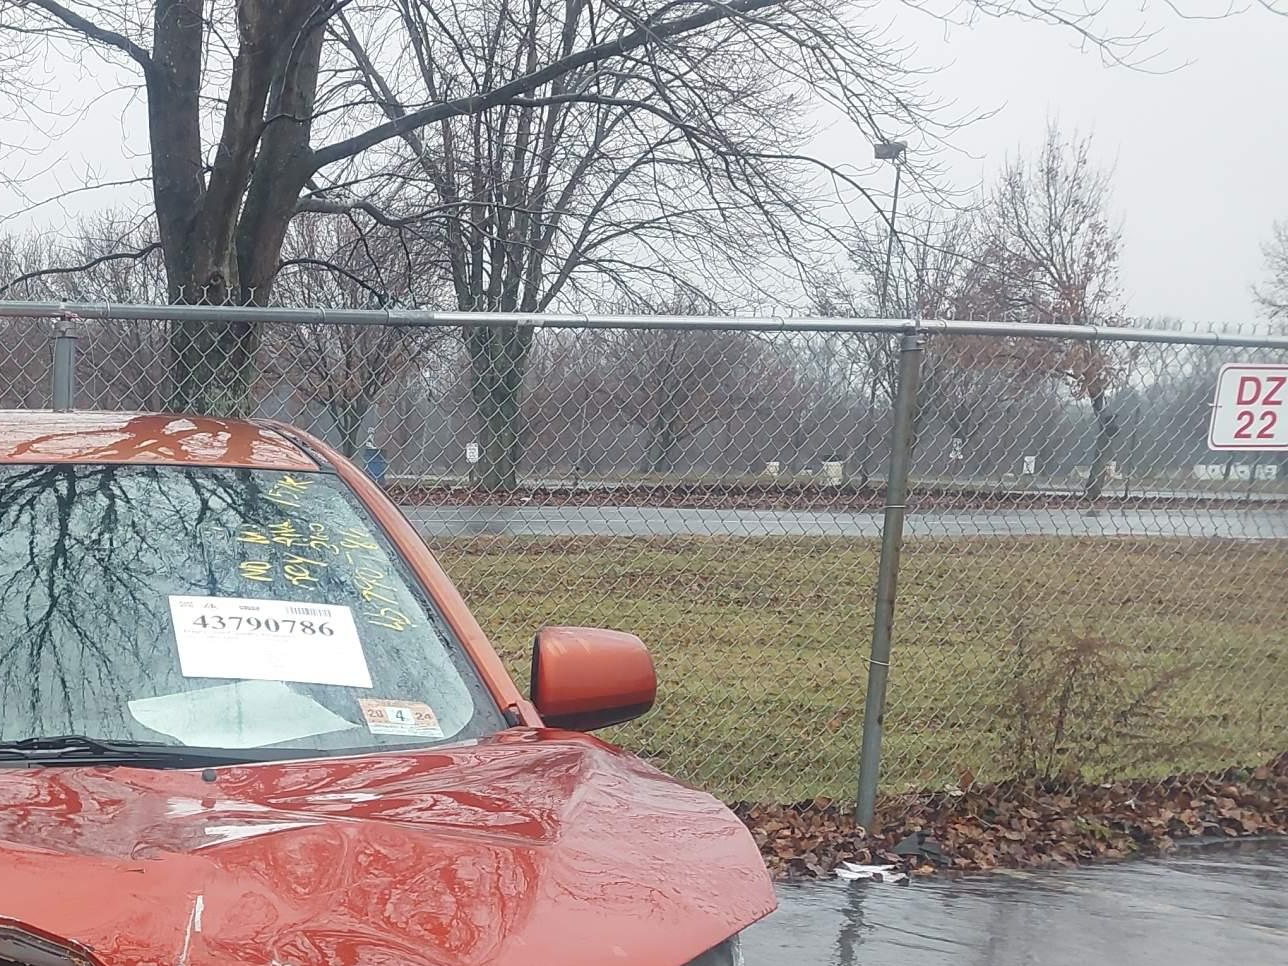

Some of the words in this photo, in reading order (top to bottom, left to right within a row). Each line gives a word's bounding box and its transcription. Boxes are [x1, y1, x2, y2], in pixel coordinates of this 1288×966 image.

[1236, 376, 1288, 406] DZ
[1233, 410, 1278, 439] 22
[192, 614, 335, 637] 43790786
[395, 709, 405, 722] 4
